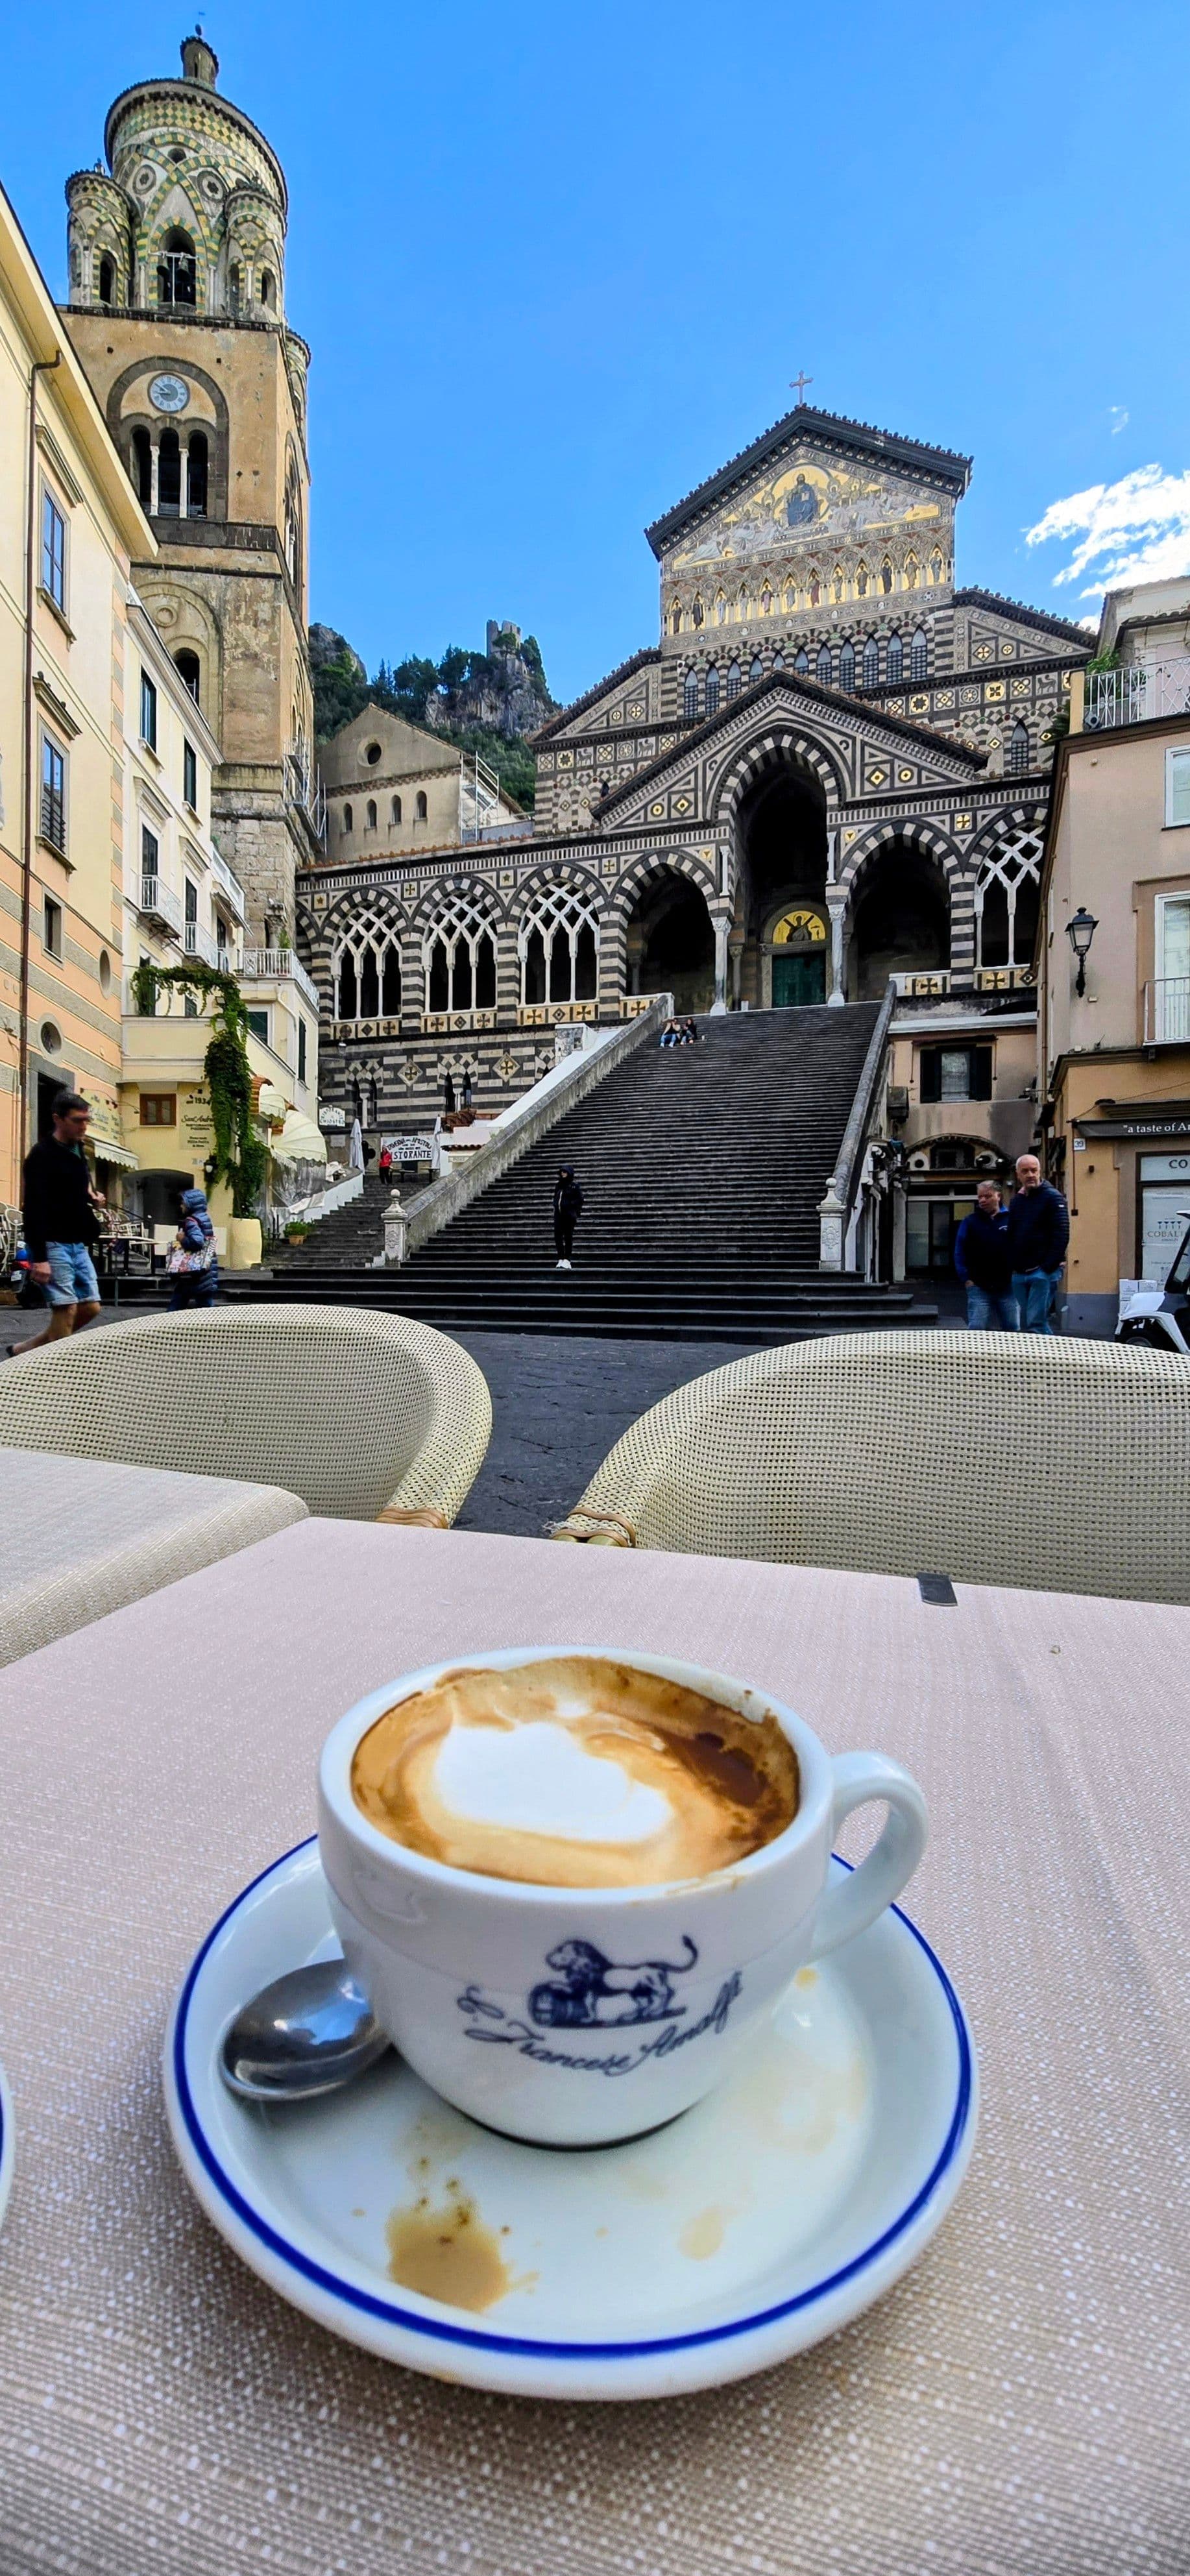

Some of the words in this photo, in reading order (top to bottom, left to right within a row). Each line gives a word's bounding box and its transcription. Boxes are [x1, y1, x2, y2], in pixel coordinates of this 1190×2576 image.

[1136, 1124, 1162, 1133] taste
[1164, 1122, 1176, 1132] of
[391, 1150, 431, 1160] STORANTE
